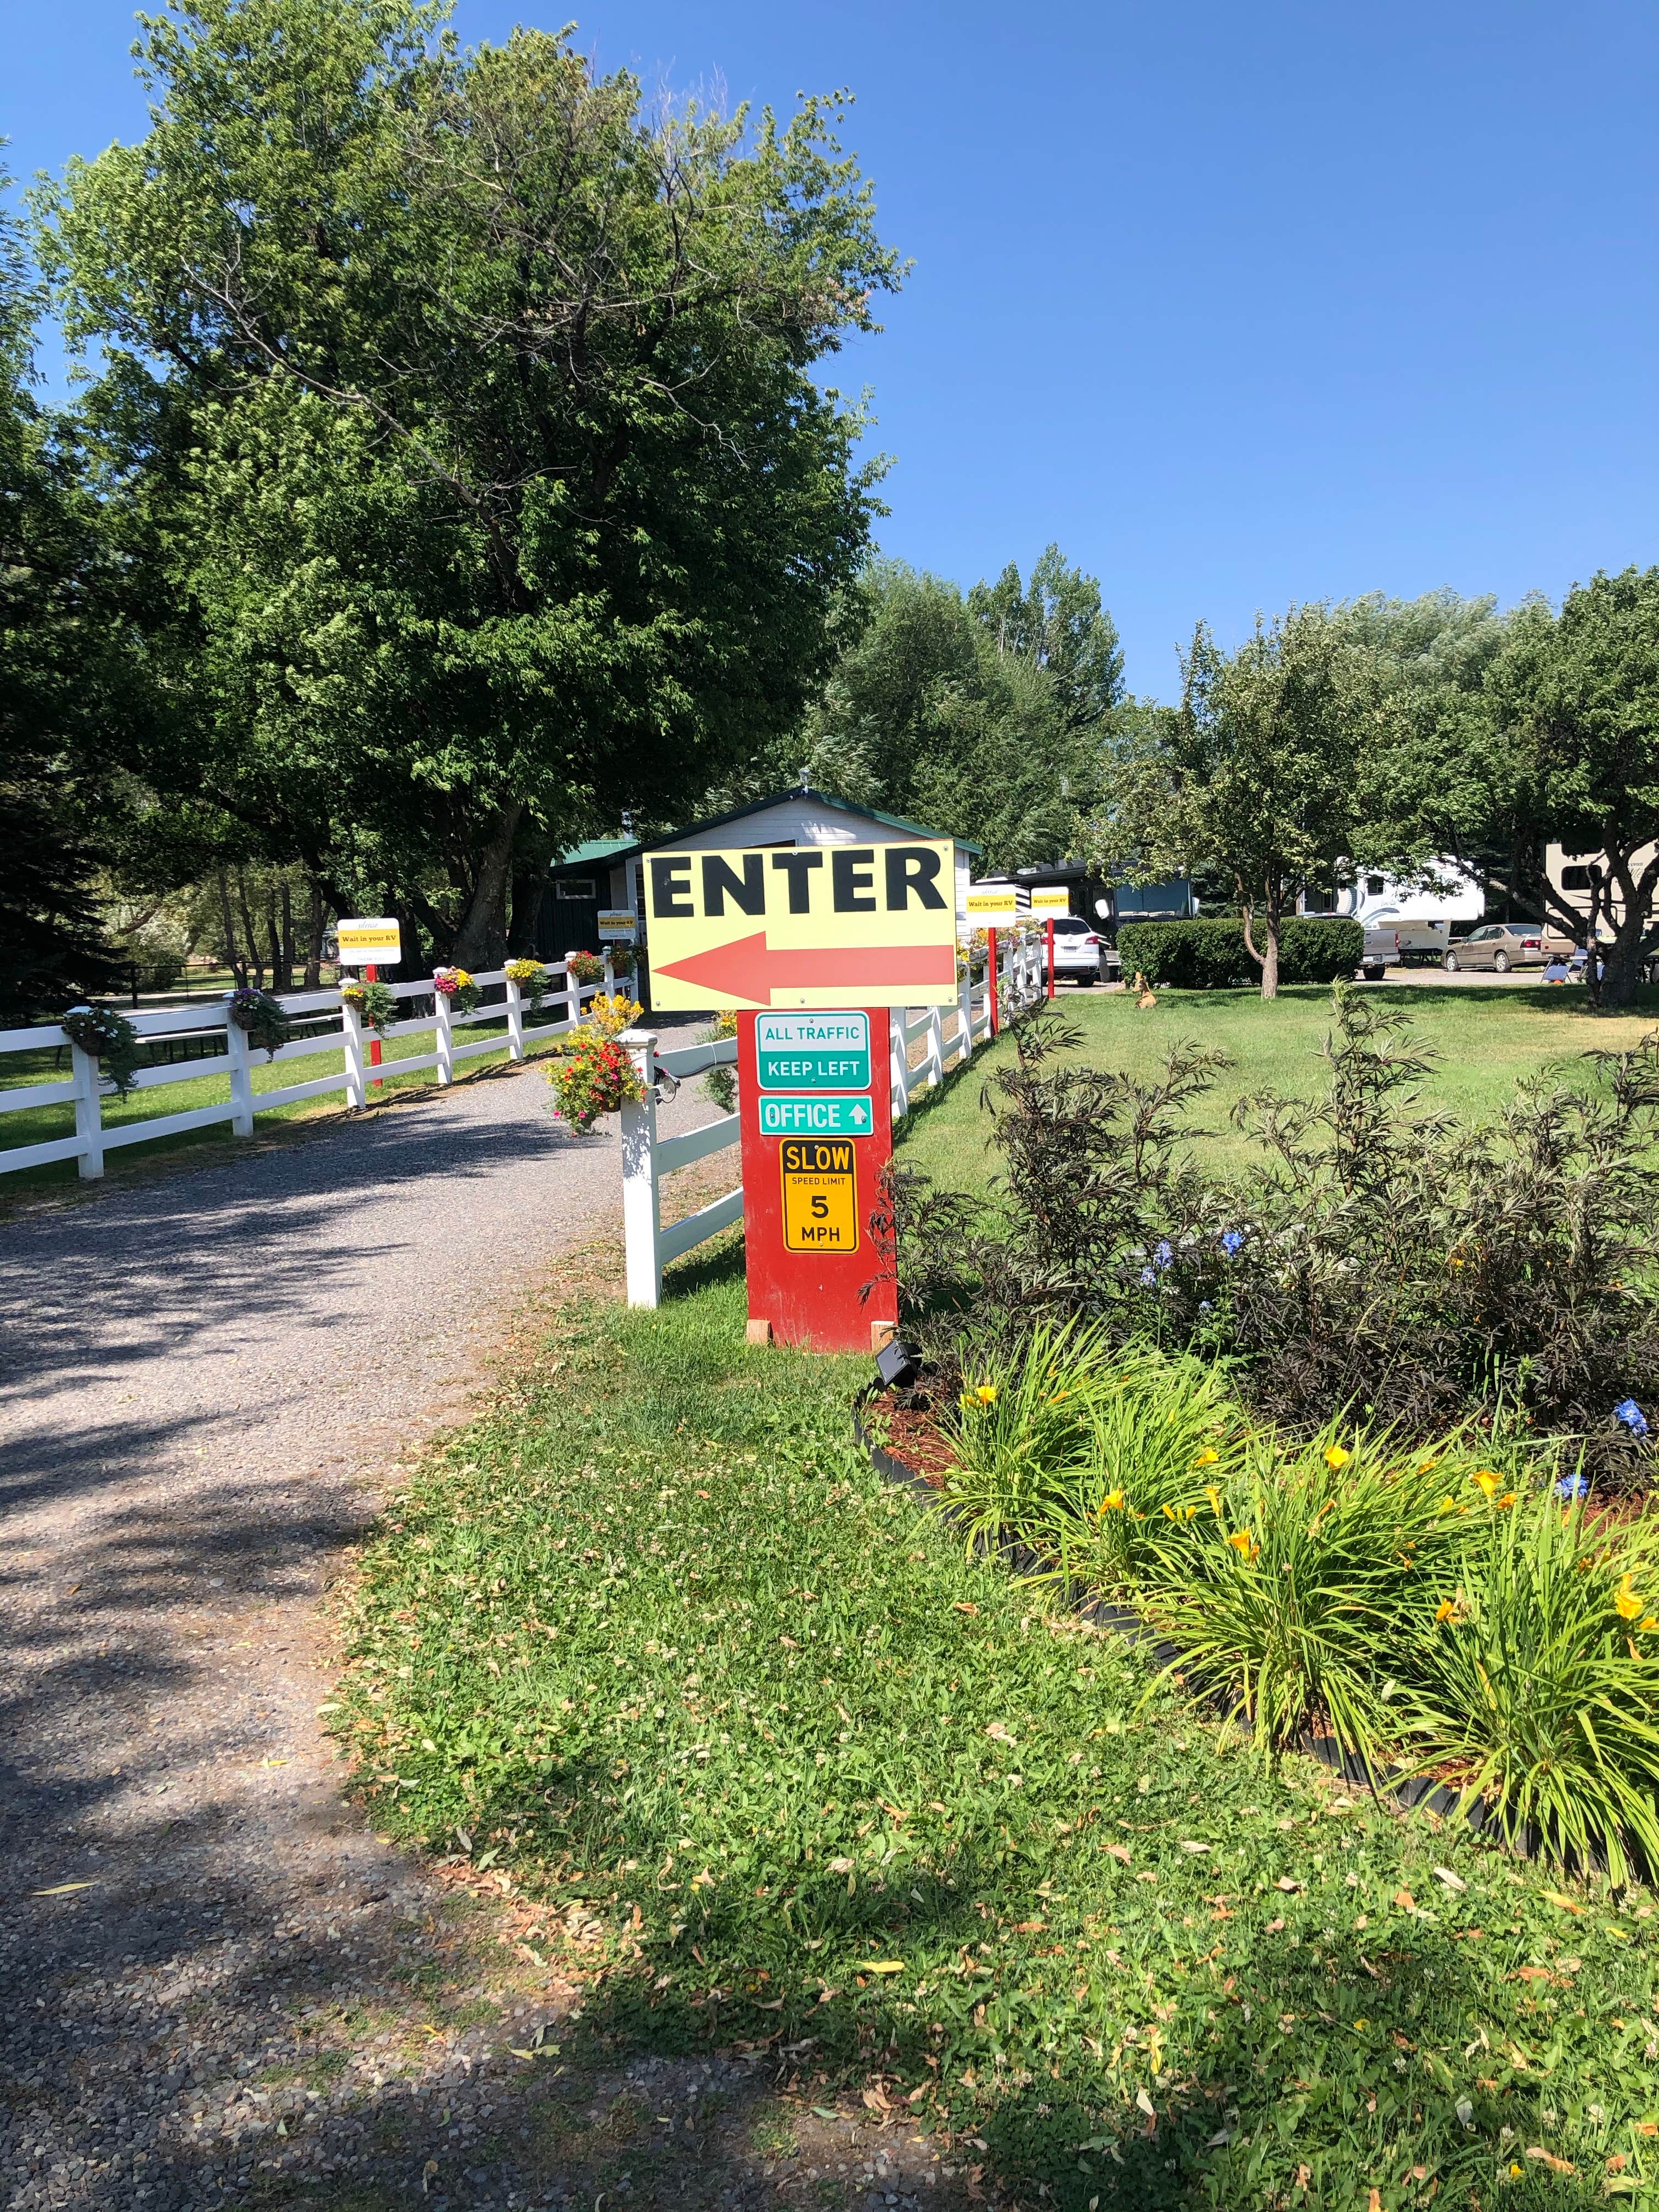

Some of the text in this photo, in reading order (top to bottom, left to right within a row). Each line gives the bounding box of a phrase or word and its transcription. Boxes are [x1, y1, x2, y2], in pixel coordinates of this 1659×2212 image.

[651, 847, 947, 918] ENTER
[358, 921, 377, 929] please
[765, 1026, 860, 1040] ALL TRAFFIC
[768, 1061, 860, 1076] KEEP LEFT
[765, 1103, 841, 1127] OFFICE
[786, 1146, 849, 1170] SLOW
[811, 1195, 829, 1218] 5
[802, 1227, 839, 1242] MPH
